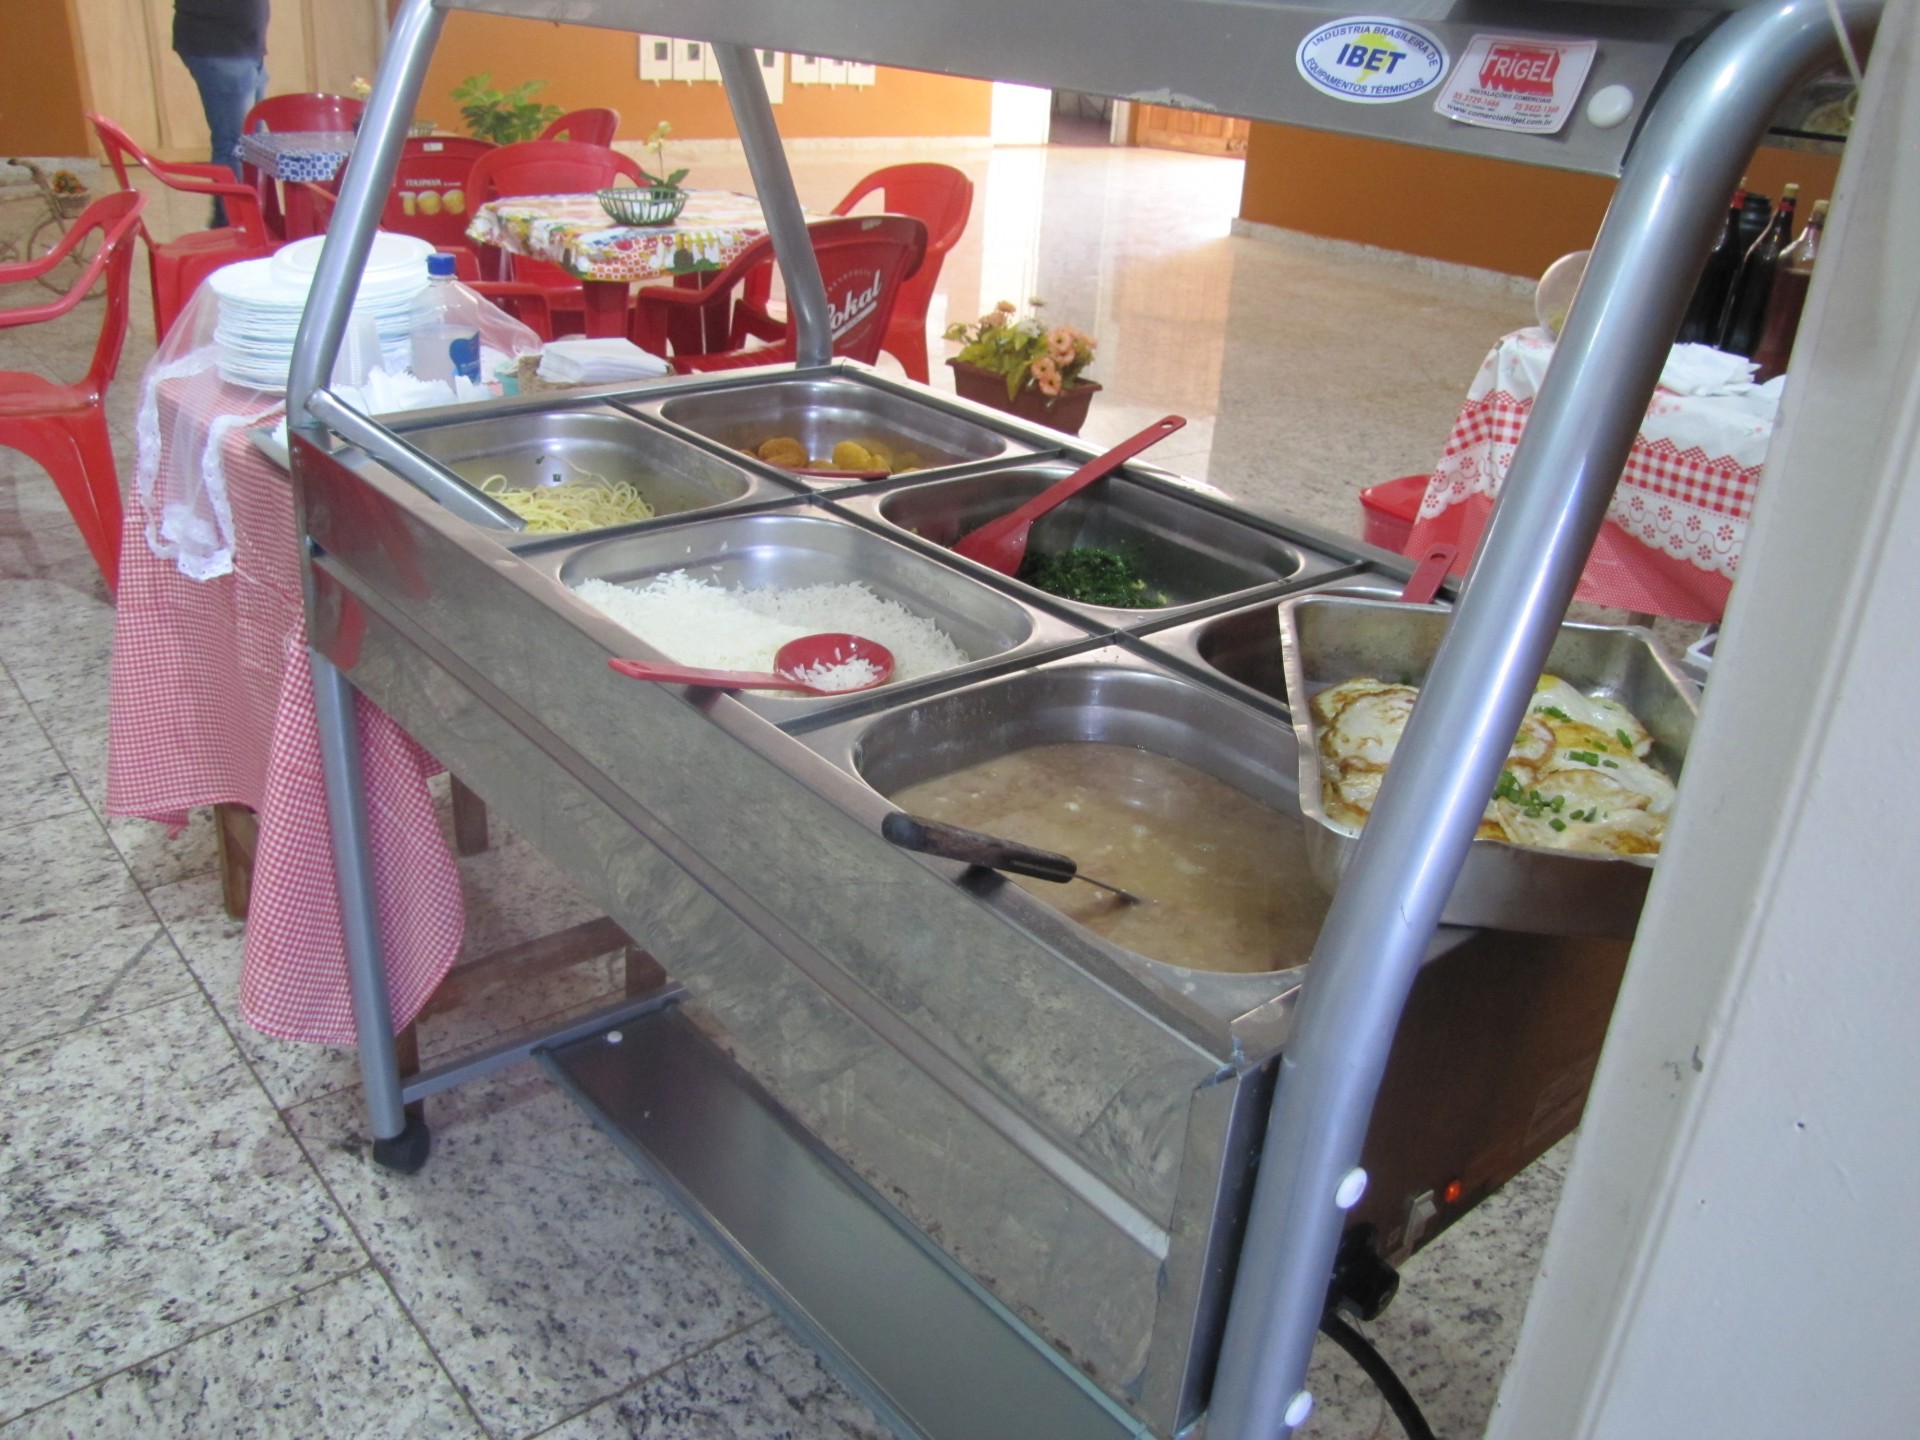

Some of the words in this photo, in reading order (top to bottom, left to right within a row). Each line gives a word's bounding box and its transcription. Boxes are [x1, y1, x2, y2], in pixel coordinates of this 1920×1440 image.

[1312, 25, 1370, 46] INDÚSTRIA
[1373, 26, 1429, 55] BRASILEIRA
[1426, 51, 1438, 67] DE
[1336, 43, 1407, 75] IBET
[1306, 57, 1367, 93] EQUIPAMENTOS
[1370, 77, 1424, 95] TÉRMICOS
[1452, 91, 1462, 101] 35
[1513, 94, 1552, 103] COMERCIAIS
[1446, 103, 1552, 126] www.comercialfrigel.com.br
